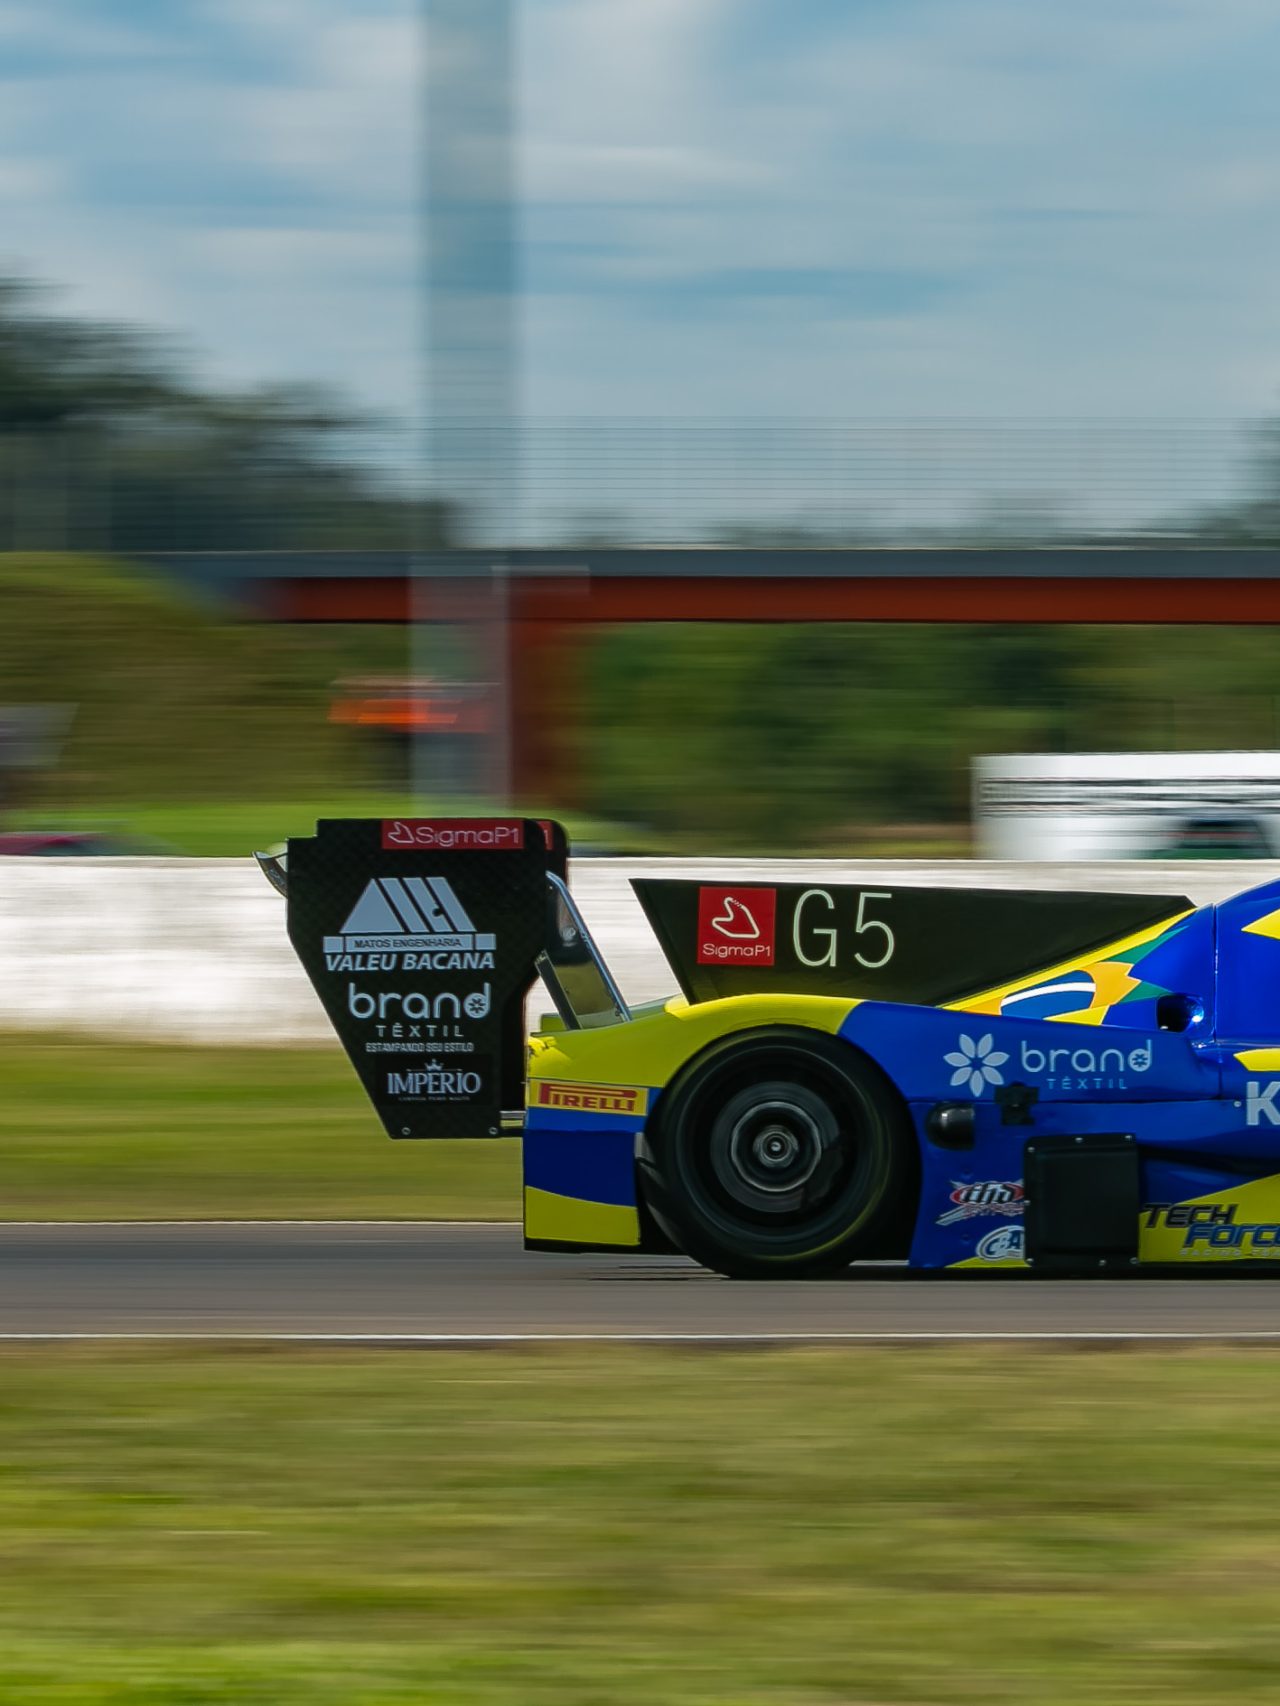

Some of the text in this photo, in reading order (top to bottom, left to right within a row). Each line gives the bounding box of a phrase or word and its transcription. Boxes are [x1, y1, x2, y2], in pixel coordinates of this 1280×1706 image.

[414, 826, 519, 848] SigmaP1
[792, 888, 895, 968] G5
[354, 938, 463, 948] MATOS ENGENHARIA
[702, 942, 771, 959] SigmaP1
[325, 951, 496, 972] VALEU BACANA
[348, 982, 492, 1020] brand
[375, 1022, 465, 1038] TÊXTIL
[1021, 1039, 1153, 1073] brand
[1046, 1076, 1128, 1090] TÊXTIL
[538, 1082, 637, 1112] PIRELLI
[1142, 1202, 1239, 1229] TECH
